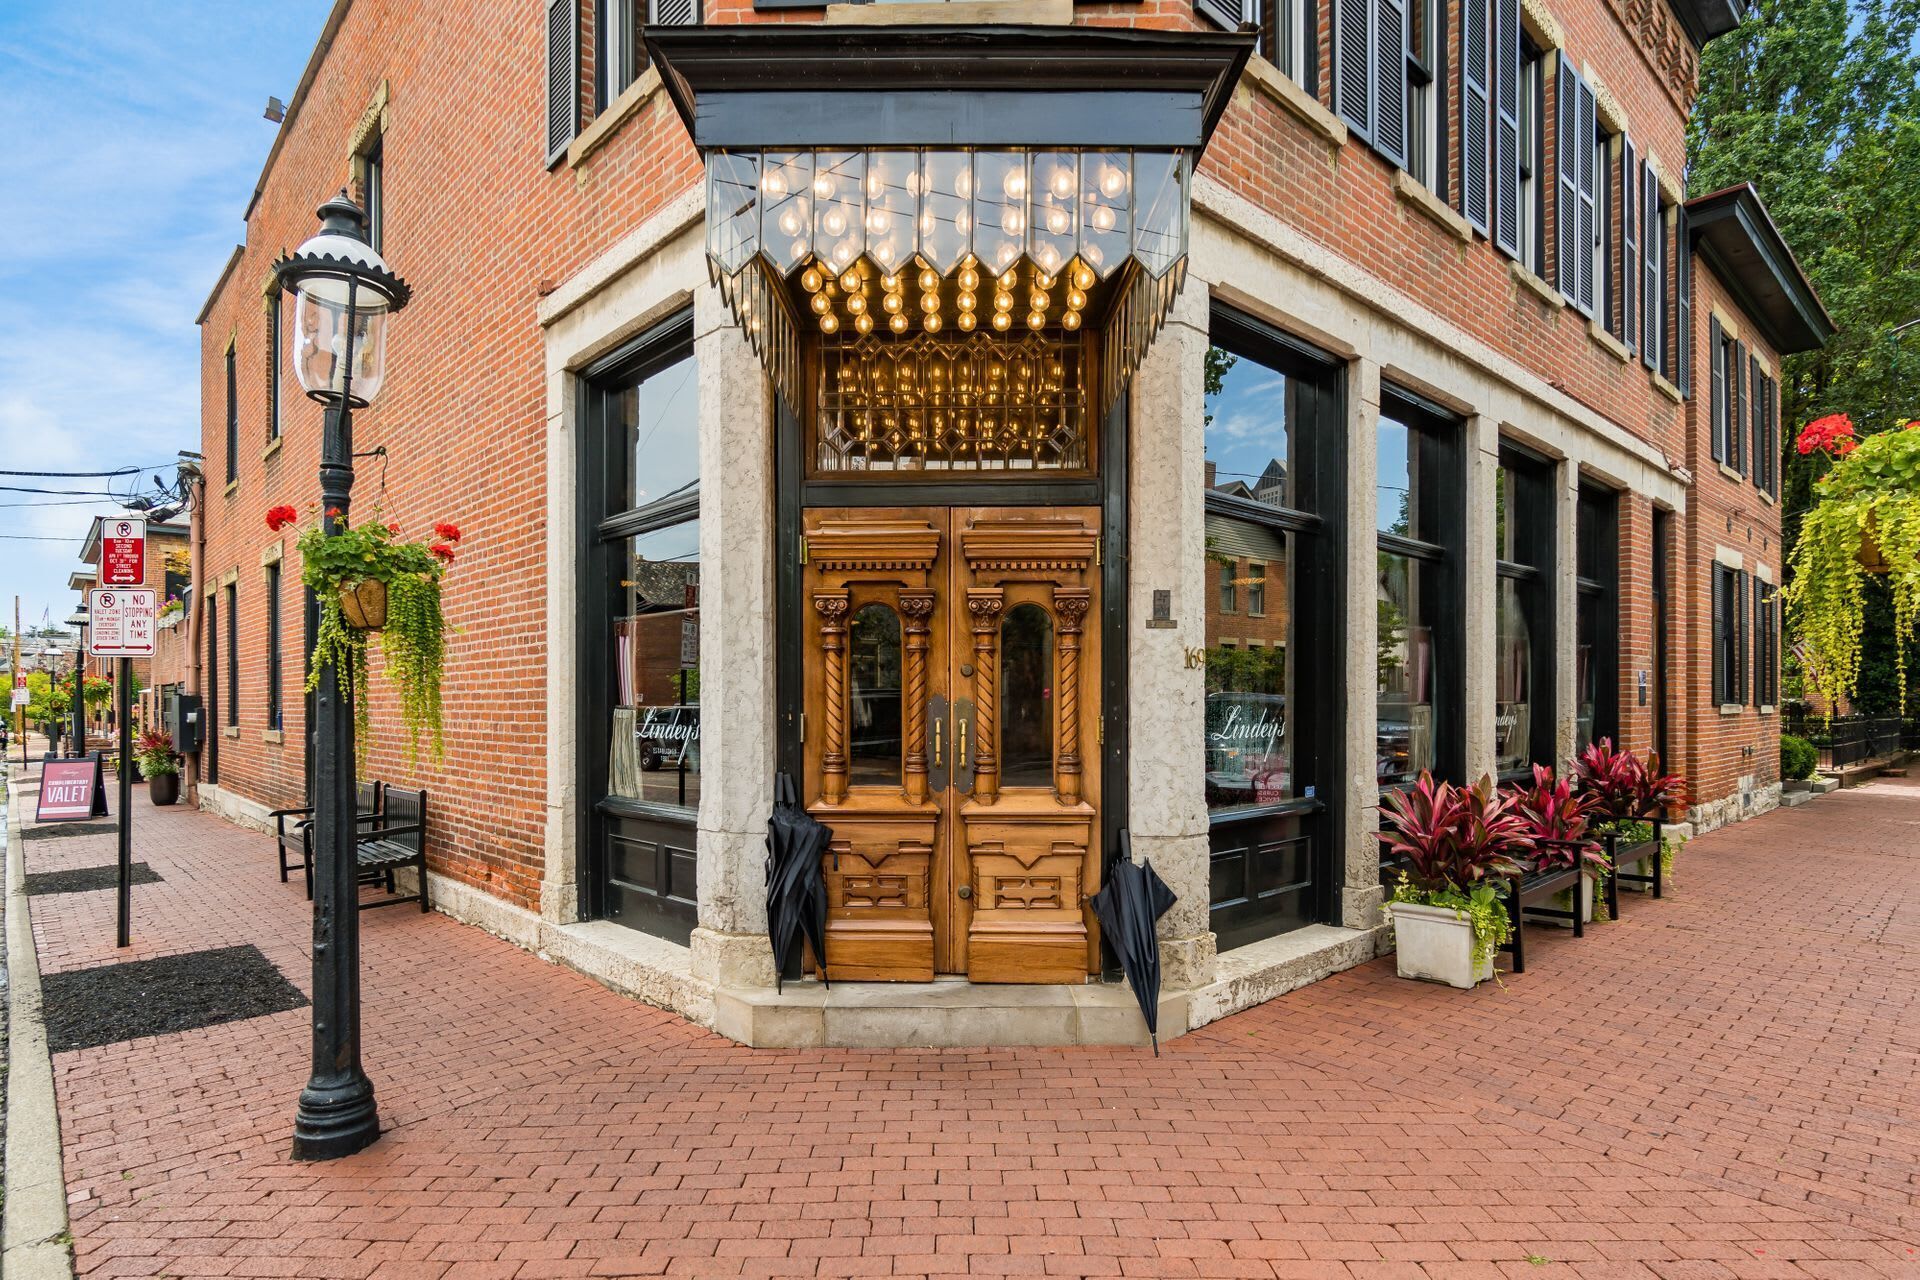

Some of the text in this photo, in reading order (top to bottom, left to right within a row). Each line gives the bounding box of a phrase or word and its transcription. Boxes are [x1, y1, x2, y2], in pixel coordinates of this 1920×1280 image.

[133, 595, 146, 605] NO
[125, 607, 153, 617] STOPPING
[131, 620, 147, 628] ANY
[130, 630, 148, 639] TIME
[1183, 645, 1206, 671] 169
[1495, 705, 1517, 742] ndey's
[633, 706, 700, 765] Lindey's
[1211, 705, 1286, 762] Lindey's
[48, 786, 87, 802] VALET
